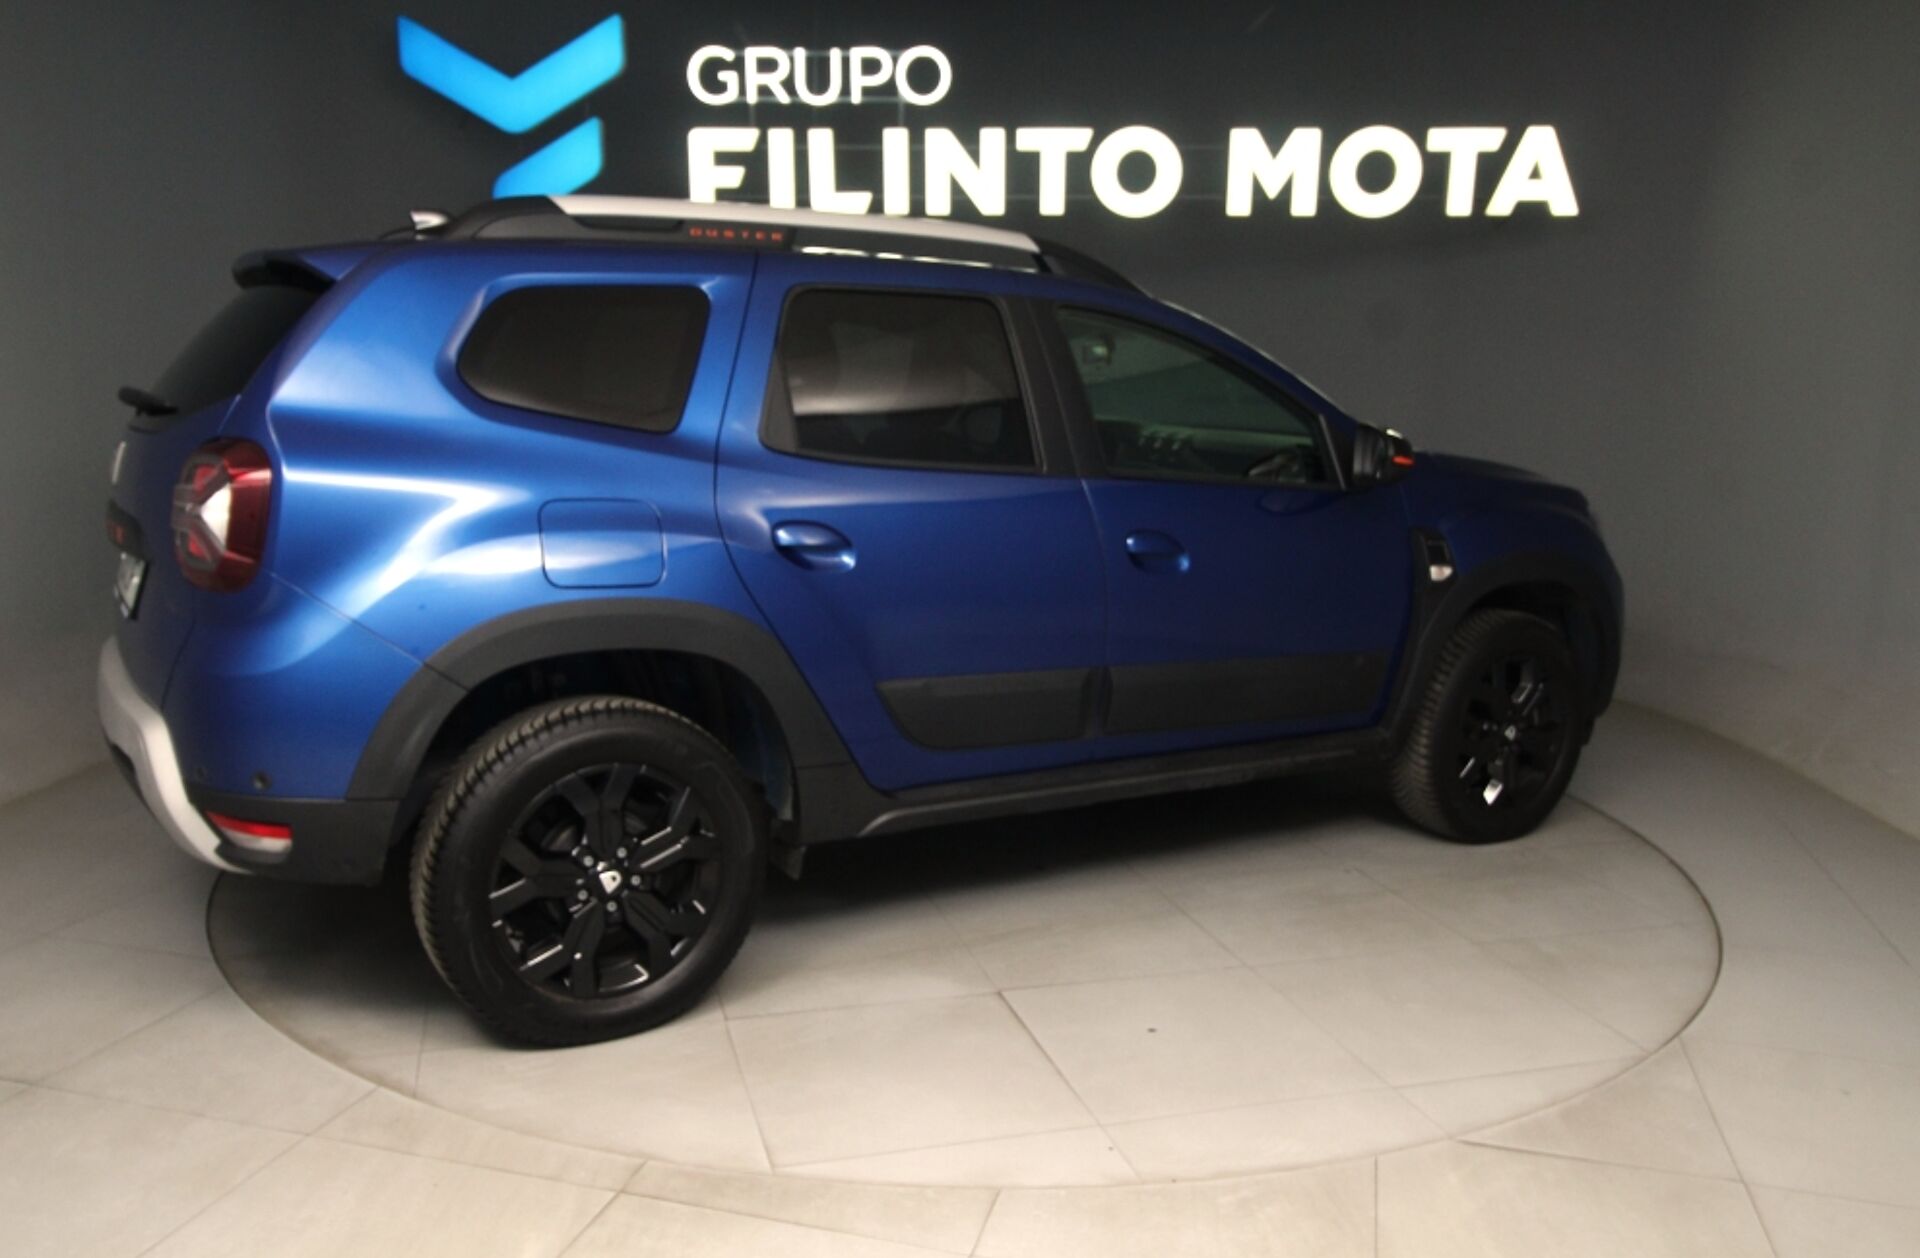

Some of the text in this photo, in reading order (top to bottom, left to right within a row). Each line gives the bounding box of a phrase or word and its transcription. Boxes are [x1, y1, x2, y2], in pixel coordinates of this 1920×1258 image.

[686, 44, 953, 107] GRUPO
[687, 124, 1580, 219] FILINTO MOTA
